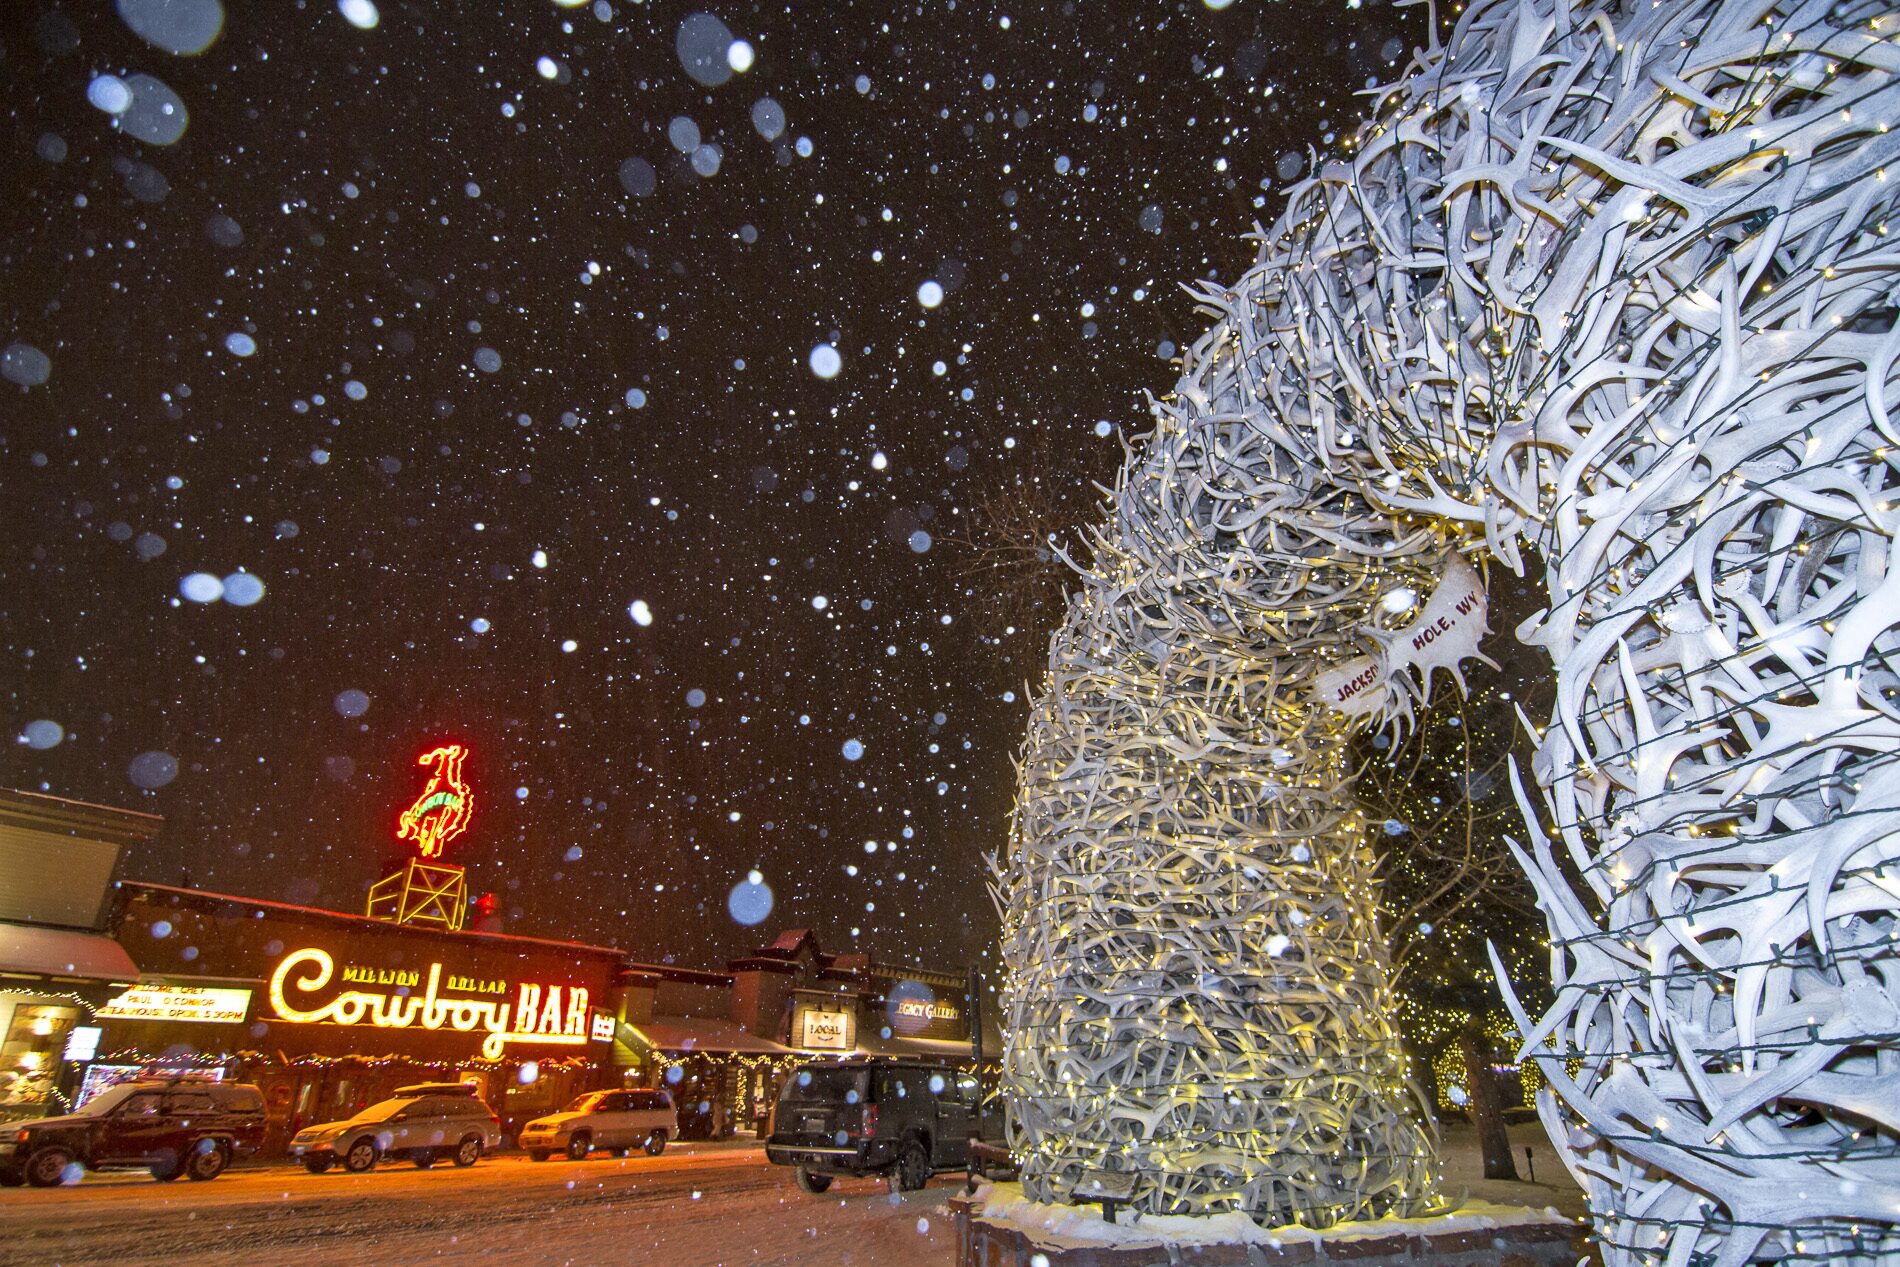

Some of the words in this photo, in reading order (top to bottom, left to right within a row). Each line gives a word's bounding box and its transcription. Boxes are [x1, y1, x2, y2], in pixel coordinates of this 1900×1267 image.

[1338, 664, 1379, 702] JACKSO
[1455, 591, 1478, 616] WY
[342, 966, 420, 987] MILLION
[446, 975, 507, 995] DOLLAR
[269, 947, 511, 1060] Cowboy
[514, 983, 589, 1035] BAR
[895, 1003, 926, 1017] EGACY
[810, 1023, 842, 1036] LOCAL
